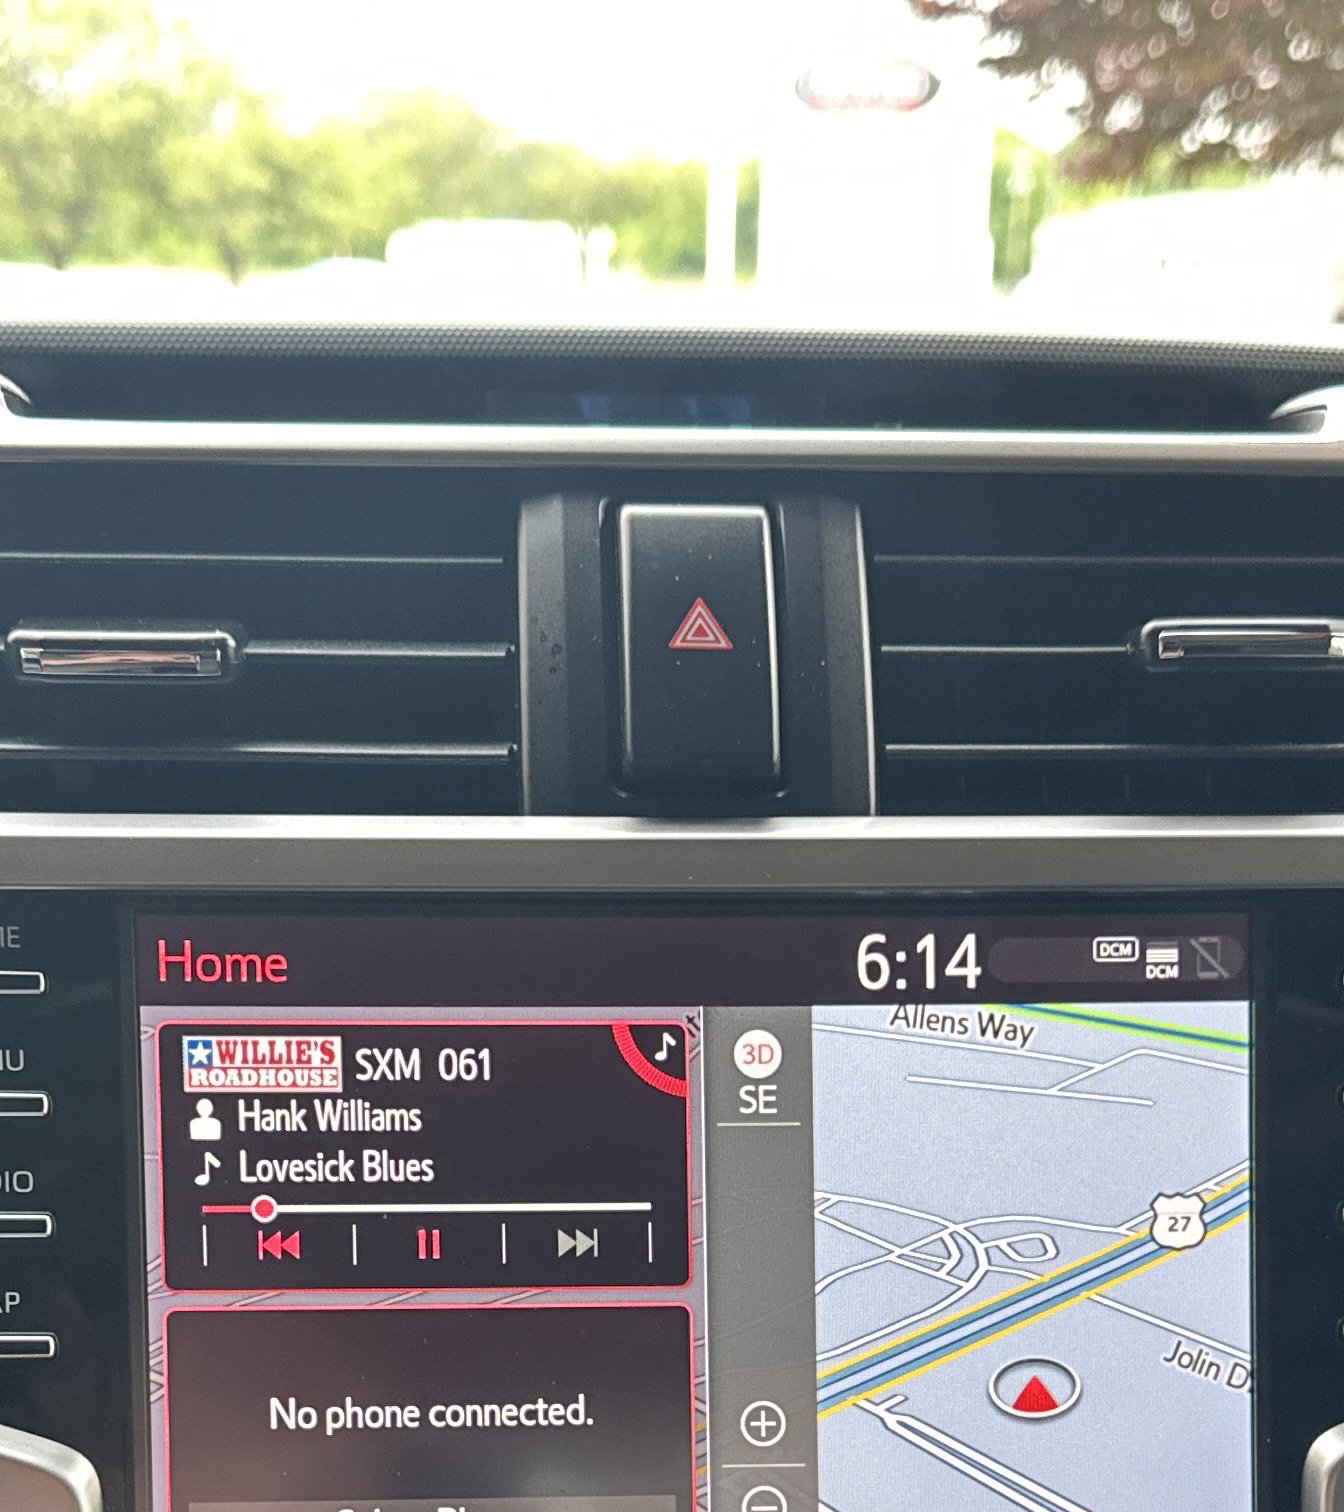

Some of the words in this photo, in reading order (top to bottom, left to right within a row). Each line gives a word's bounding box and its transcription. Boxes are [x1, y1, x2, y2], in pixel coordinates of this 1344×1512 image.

[157, 938, 289, 984] Home
[856, 932, 983, 991] 6:14
[1099, 942, 1133, 957] DCM
[1145, 964, 1179, 979] DCM
[889, 1003, 969, 1035] Allens
[977, 1011, 1035, 1048] Way
[214, 1038, 336, 1066] WILLIE'S
[355, 1047, 422, 1082] SXM
[437, 1047, 491, 1082] 061
[740, 1043, 775, 1066] 3D
[190, 1067, 339, 1088] ROADHOUSE
[237, 1098, 308, 1133] Hank
[312, 1098, 424, 1133] Williams
[738, 1085, 779, 1115] SE
[239, 1148, 356, 1184] Lovesick
[361, 1148, 436, 1183] Blues
[1167, 1214, 1192, 1234] 27
[1162, 1339, 1222, 1382] Jolin
[1225, 1361, 1254, 1393] D
[268, 1397, 319, 1431] No
[324, 1395, 422, 1436] phone
[427, 1393, 595, 1429] connected.
